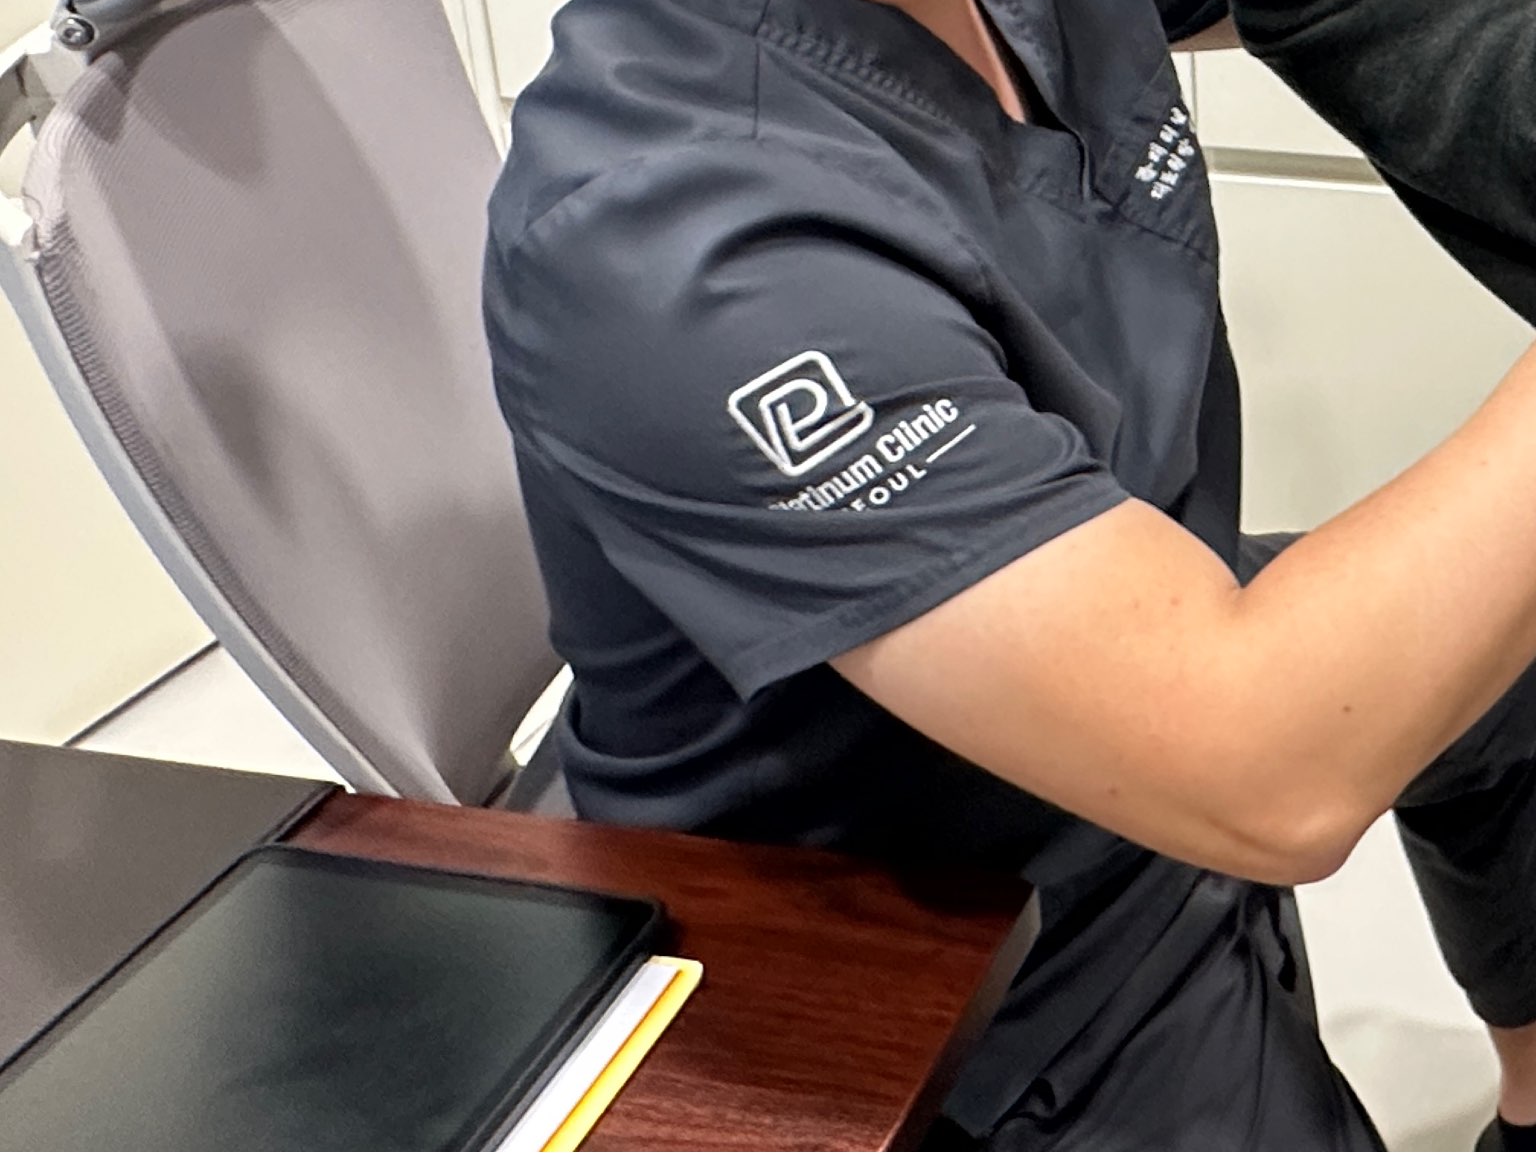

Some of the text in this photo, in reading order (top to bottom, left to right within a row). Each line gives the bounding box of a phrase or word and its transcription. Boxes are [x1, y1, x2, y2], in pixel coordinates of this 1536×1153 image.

[768, 398, 959, 511] atinum Clinic
[841, 462, 928, 512] EOUL
